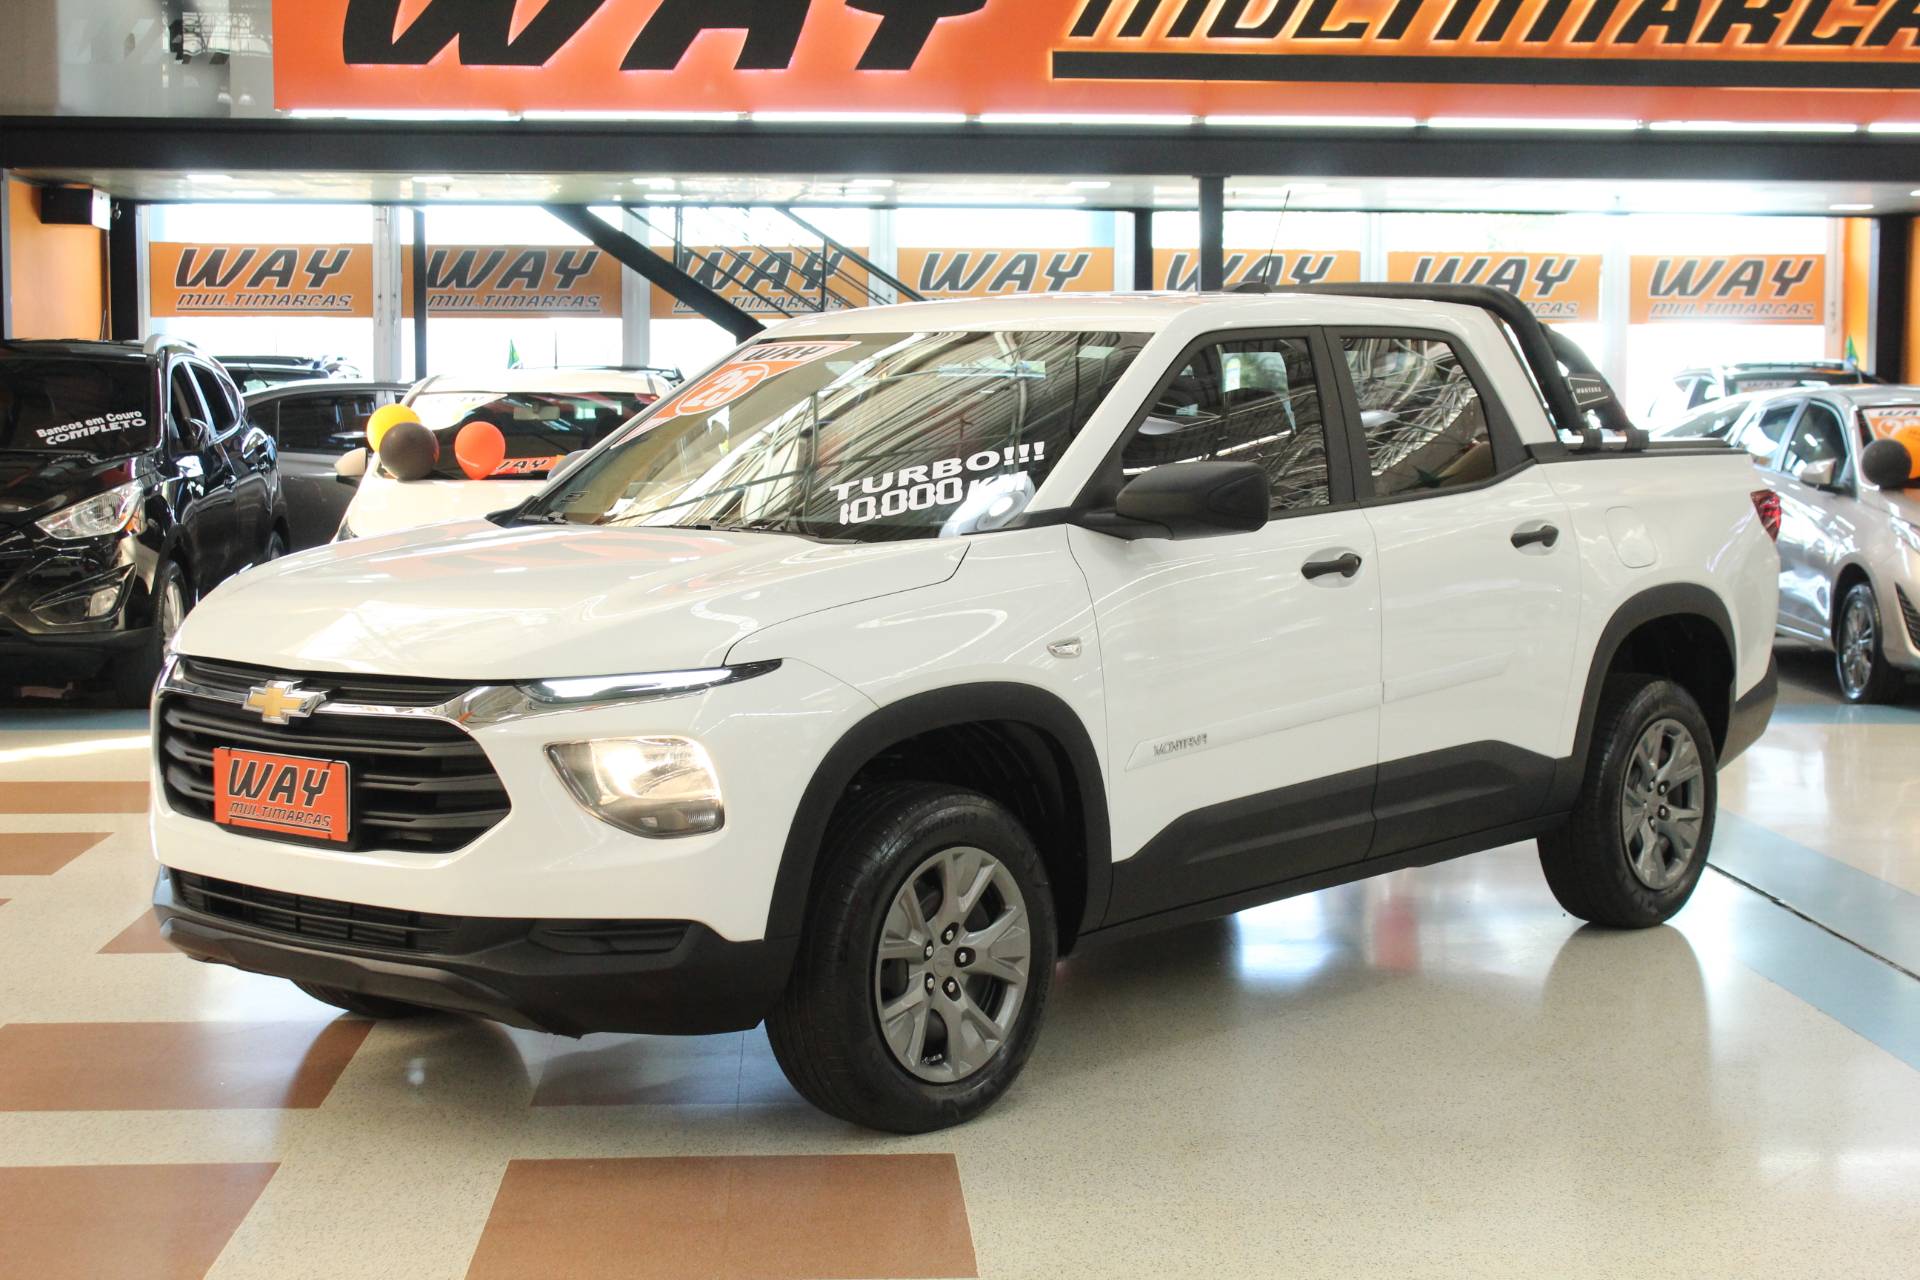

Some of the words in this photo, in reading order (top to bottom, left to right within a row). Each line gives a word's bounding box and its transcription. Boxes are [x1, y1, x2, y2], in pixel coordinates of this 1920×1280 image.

[174, 247, 353, 290] WAY
[426, 249, 600, 291] WAY
[917, 250, 1093, 293] WAY
[1166, 252, 1338, 291] WAY
[1410, 256, 1580, 297] WAY
[1648, 257, 1816, 299] WAY
[177, 293, 353, 307] MULTIMARCAS
[427, 295, 601, 308] MULTIMARCAS
[1650, 303, 1815, 315] MULTIMARCAS
[36, 422, 83, 438] Bancos
[85, 416, 105, 427] em
[106, 410, 142, 422] Couro
[46, 418, 147, 445] COMPLETO
[829, 441, 1045, 500] TURBO!!!
[839, 477, 964, 526] 10.000
[228, 757, 332, 808] WAY
[229, 802, 332, 828] MULTIMARCAS
